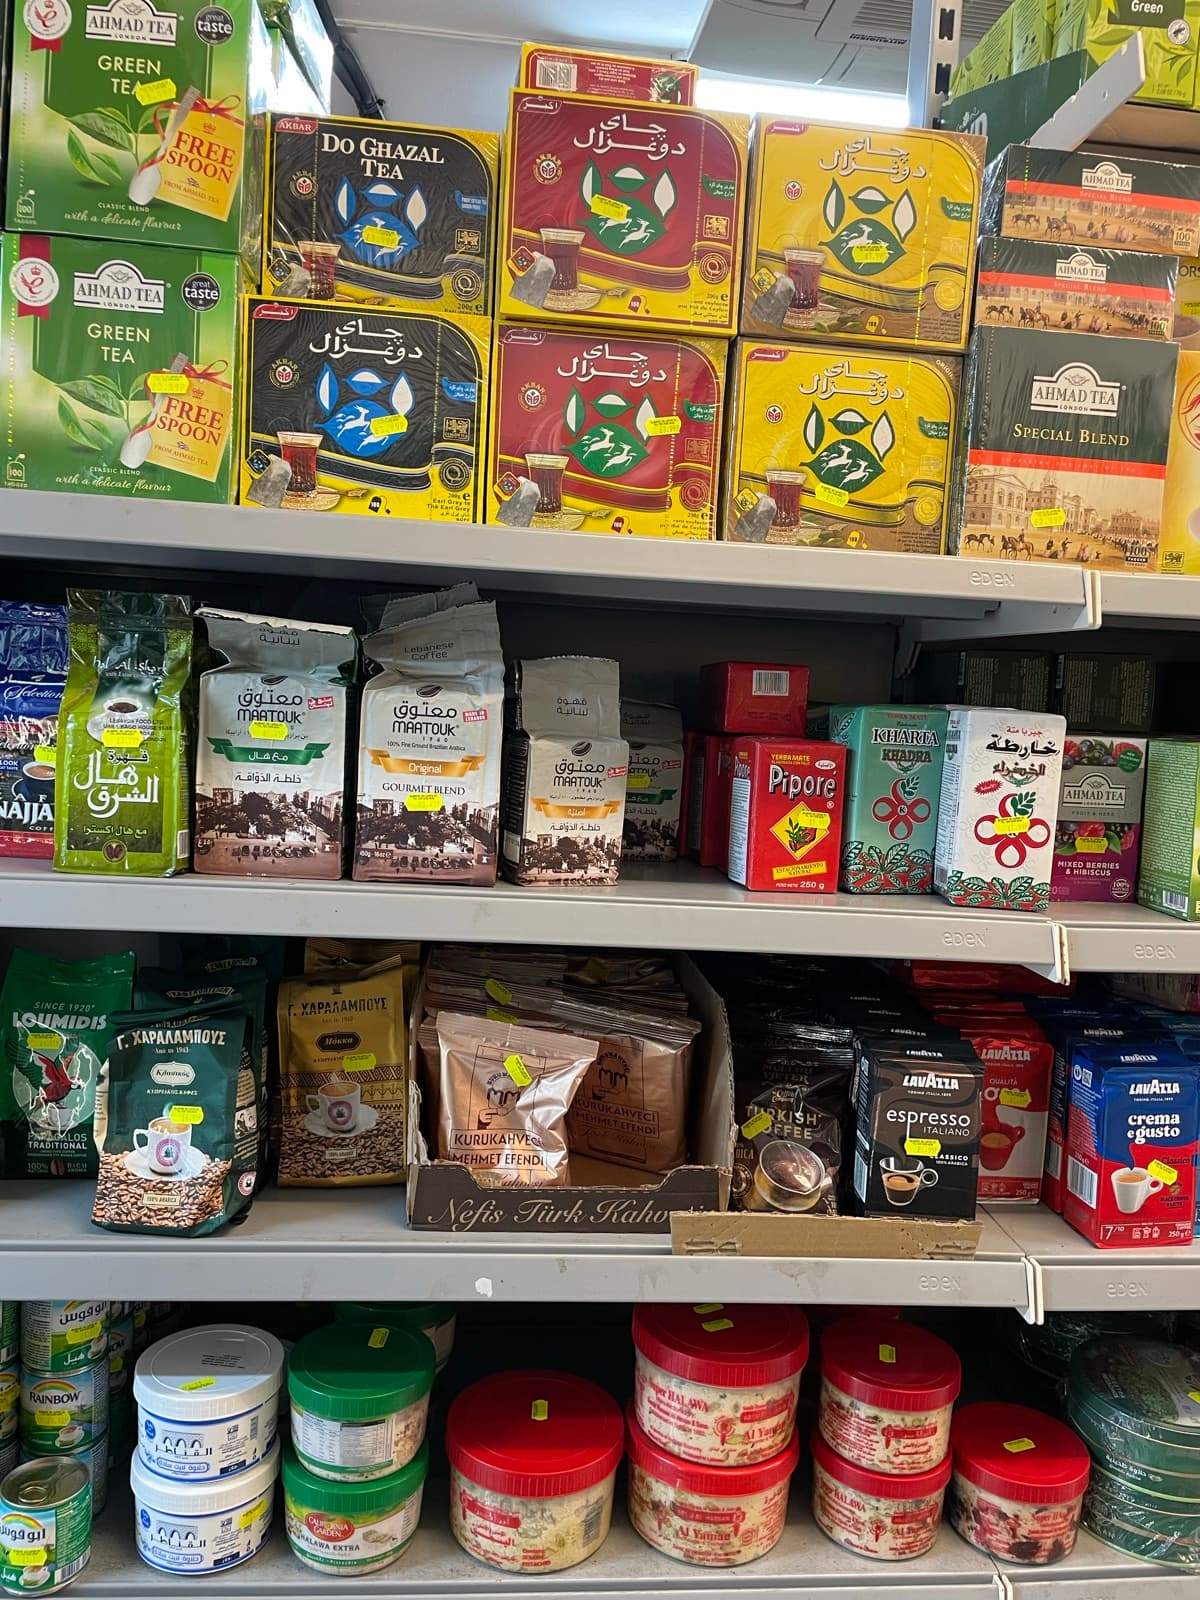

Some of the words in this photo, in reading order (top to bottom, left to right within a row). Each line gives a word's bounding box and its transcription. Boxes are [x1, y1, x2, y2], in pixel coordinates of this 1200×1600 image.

[1131, 1, 1164, 14] Green
[88, 15, 144, 31] AHMAD
[146, 19, 175, 35] TEA
[205, 14, 224, 23] great
[198, 22, 233, 35] taste
[113, 33, 147, 41] LONDON
[97, 55, 161, 75] GREEN
[278, 122, 312, 132] AKBAR
[174, 131, 236, 167] FREE
[166, 150, 233, 184] SPOON
[361, 159, 404, 180] TEA
[1083, 175, 1114, 187] AHMAD
[1115, 178, 1132, 188] TEA
[98, 202, 126, 211] CLASSIC
[128, 204, 150, 213] BLEND
[64, 210, 88, 222] with
[101, 213, 141, 227] delicate
[141, 215, 182, 232] flavour
[1175, 232, 1191, 242] 100
[1058, 265, 1090, 278] AHMAD
[1090, 269, 1105, 279] TEA
[192, 280, 211, 289] great
[76, 282, 133, 299] AHMAD
[134, 286, 163, 305] TEA
[184, 287, 219, 301] taste
[103, 301, 136, 310] LONDON
[87, 323, 150, 343] GREEN
[1150, 321, 1166, 331] 100
[101, 346, 135, 364] TEA
[1034, 385, 1088, 403] AHMAD
[1090, 390, 1116, 406] TEA
[163, 396, 224, 431] FREE
[1058, 404, 1089, 412] LONDON
[157, 415, 222, 447] SPOON
[1013, 423, 1072, 442] SPECIAL
[1079, 429, 1130, 447] BLEND
[55, 475, 80, 485] with
[92, 477, 132, 490] delicate
[132, 478, 173, 495] flavour
[404, 642, 454, 654] Lebanese
[411, 651, 448, 662] Coffee
[238, 688, 303, 708] معتوق
[237, 708, 302, 724] MAATOUK
[393, 700, 458, 720] معتوق
[392, 721, 456, 737] MAATOUK
[872, 728, 939, 747] KHARTA
[248, 751, 271, 761] هال
[271, 752, 288, 762] مع
[881, 748, 933, 763] KHADRA
[408, 763, 442, 775] Original
[555, 759, 605, 776] معتوق
[553, 775, 603, 788] MAATOUK
[769, 764, 838, 801] Piporé
[87, 775, 160, 818] الشرق
[382, 783, 433, 794] GOURMET
[434, 785, 465, 797] BLEND
[1065, 790, 1103, 800] AHMAD
[1104, 792, 1124, 801] TEA
[136, 826, 147, 836] مع
[776, 863, 824, 874] ESTACIONAMIENTO
[1086, 862, 1120, 870] BERRIES
[800, 881, 816, 889] 250
[34, 1001, 65, 1011] SINCE
[301, 996, 388, 1017] ΧΑΡΑΛΑΜΠΟΥΣ
[12, 1012, 107, 1031] LOUMIDIS
[117, 1034, 129, 1050] Γ.
[132, 1029, 227, 1046] ΧΑΡΑΛΑΜΠΟΥΣ
[981, 1045, 1031, 1061] LAVAZZA
[1120, 1054, 1158, 1063] LAVAZZA
[903, 1072, 960, 1090] LAVAZZA
[989, 1077, 1018, 1086] QUALITÀ
[1129, 1079, 1180, 1095] LAVAZZA
[576, 1111, 619, 1129] MEHMET
[886, 1109, 971, 1140] espresso
[1128, 1114, 1180, 1126] crema
[27, 1132, 87, 1142] PAPAGALOS
[923, 1127, 970, 1137] ITALIANO
[1127, 1130, 1134, 1139] e
[1134, 1125, 1181, 1144] gusto
[28, 1141, 87, 1150] TRADITIONAL
[27, 1162, 49, 1170] 100%
[453, 1152, 502, 1166] MEHMET
[428, 1199, 504, 1231] Nefis
[514, 1199, 588, 1225] Türk
[1168, 1231, 1180, 1239] 250
[29, 1391, 80, 1405] RAINBOW
[27, 1527, 46, 1543] ابو
[313, 1526, 342, 1537] GARDEN
[678, 1525, 690, 1536] Al
[300, 1533, 331, 1551] HALAWA
[332, 1544, 360, 1552] EXTRA
